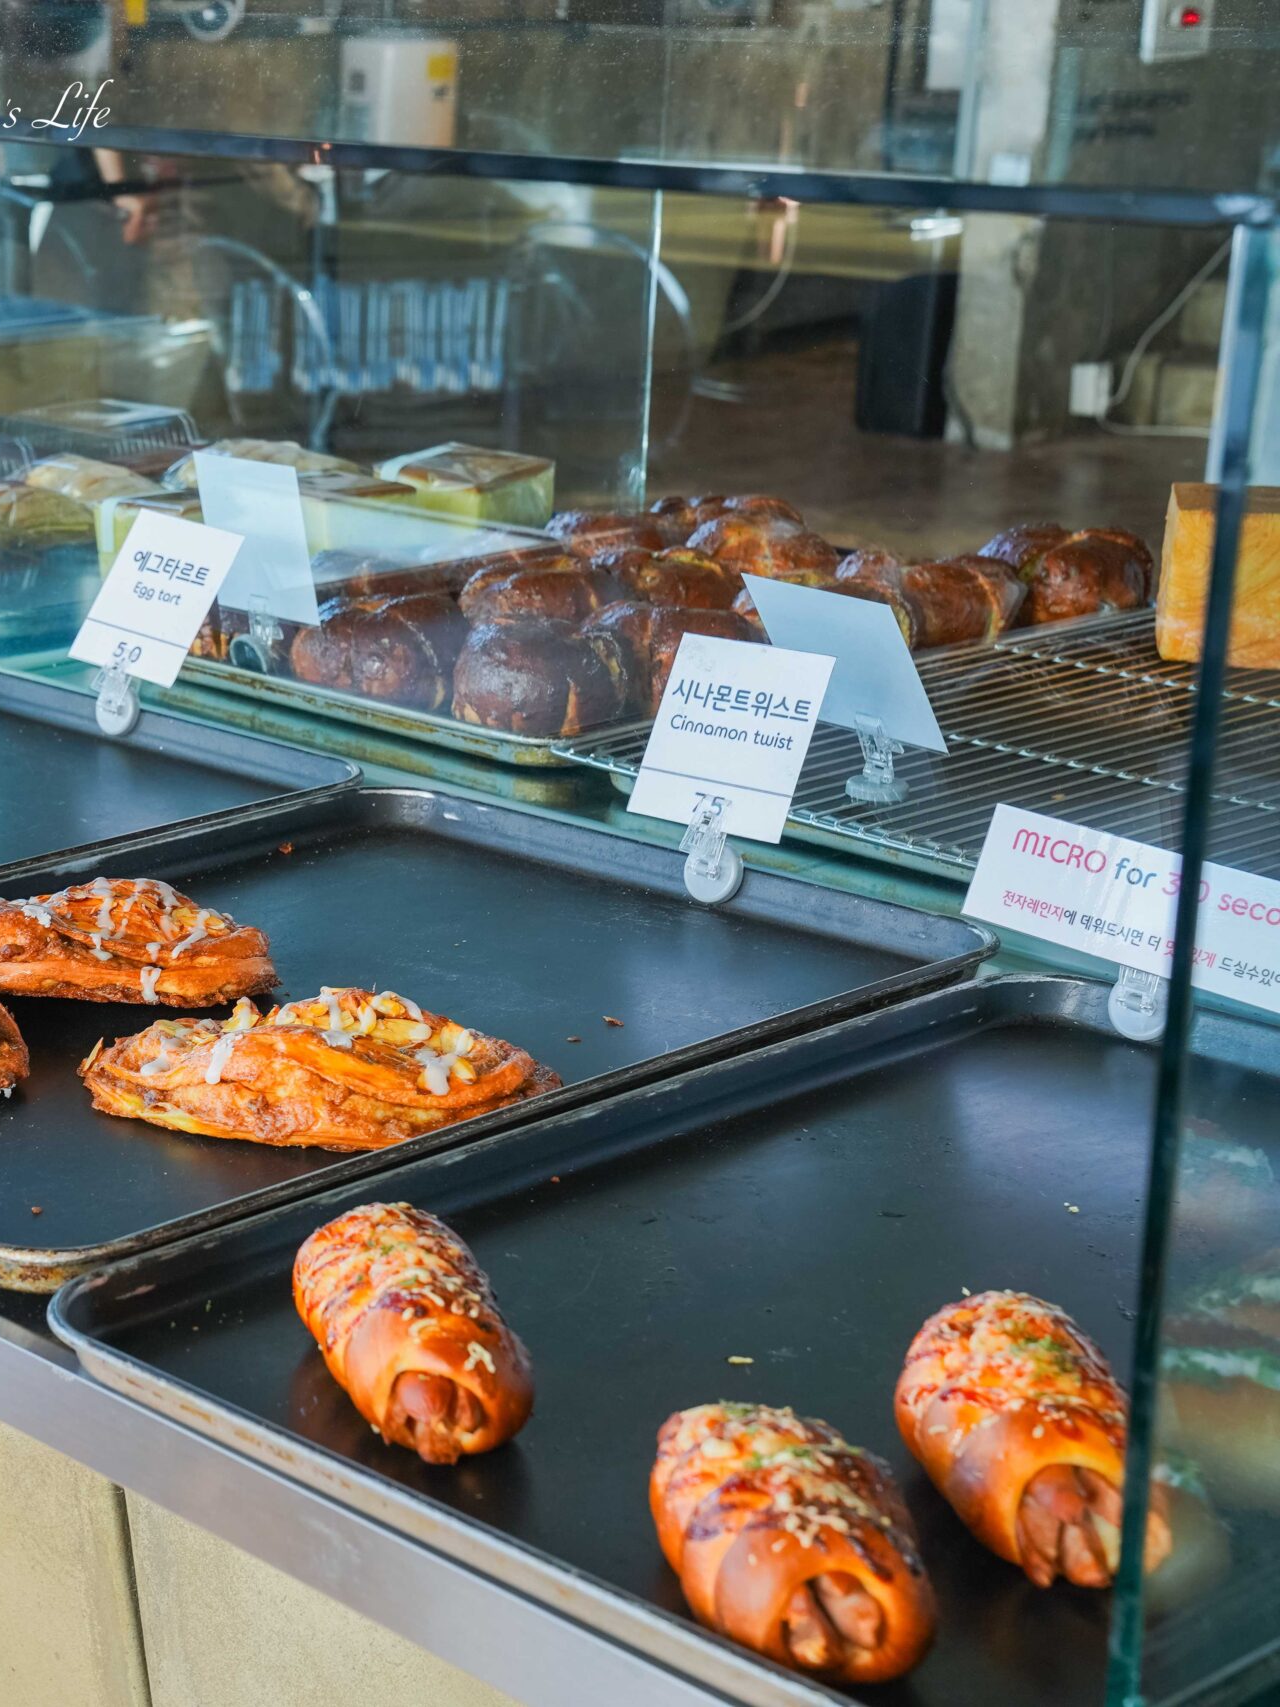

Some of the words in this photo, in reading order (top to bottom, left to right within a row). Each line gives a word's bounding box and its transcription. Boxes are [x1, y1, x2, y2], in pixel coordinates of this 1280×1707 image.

[133, 551, 210, 586] 에그타르트
[132, 581, 156, 600] Egg
[159, 588, 182, 605] tart
[672, 678, 812, 722] 시나몬트위스트
[670, 714, 748, 742] Cinnamon
[754, 730, 794, 751] twist
[1012, 827, 1107, 874] MICRO
[1114, 857, 1157, 889] for
[1002, 889, 1078, 926] 전자레인지에
[1080, 913, 1144, 948] 데워드시면
[1148, 935, 1163, 952] 더
